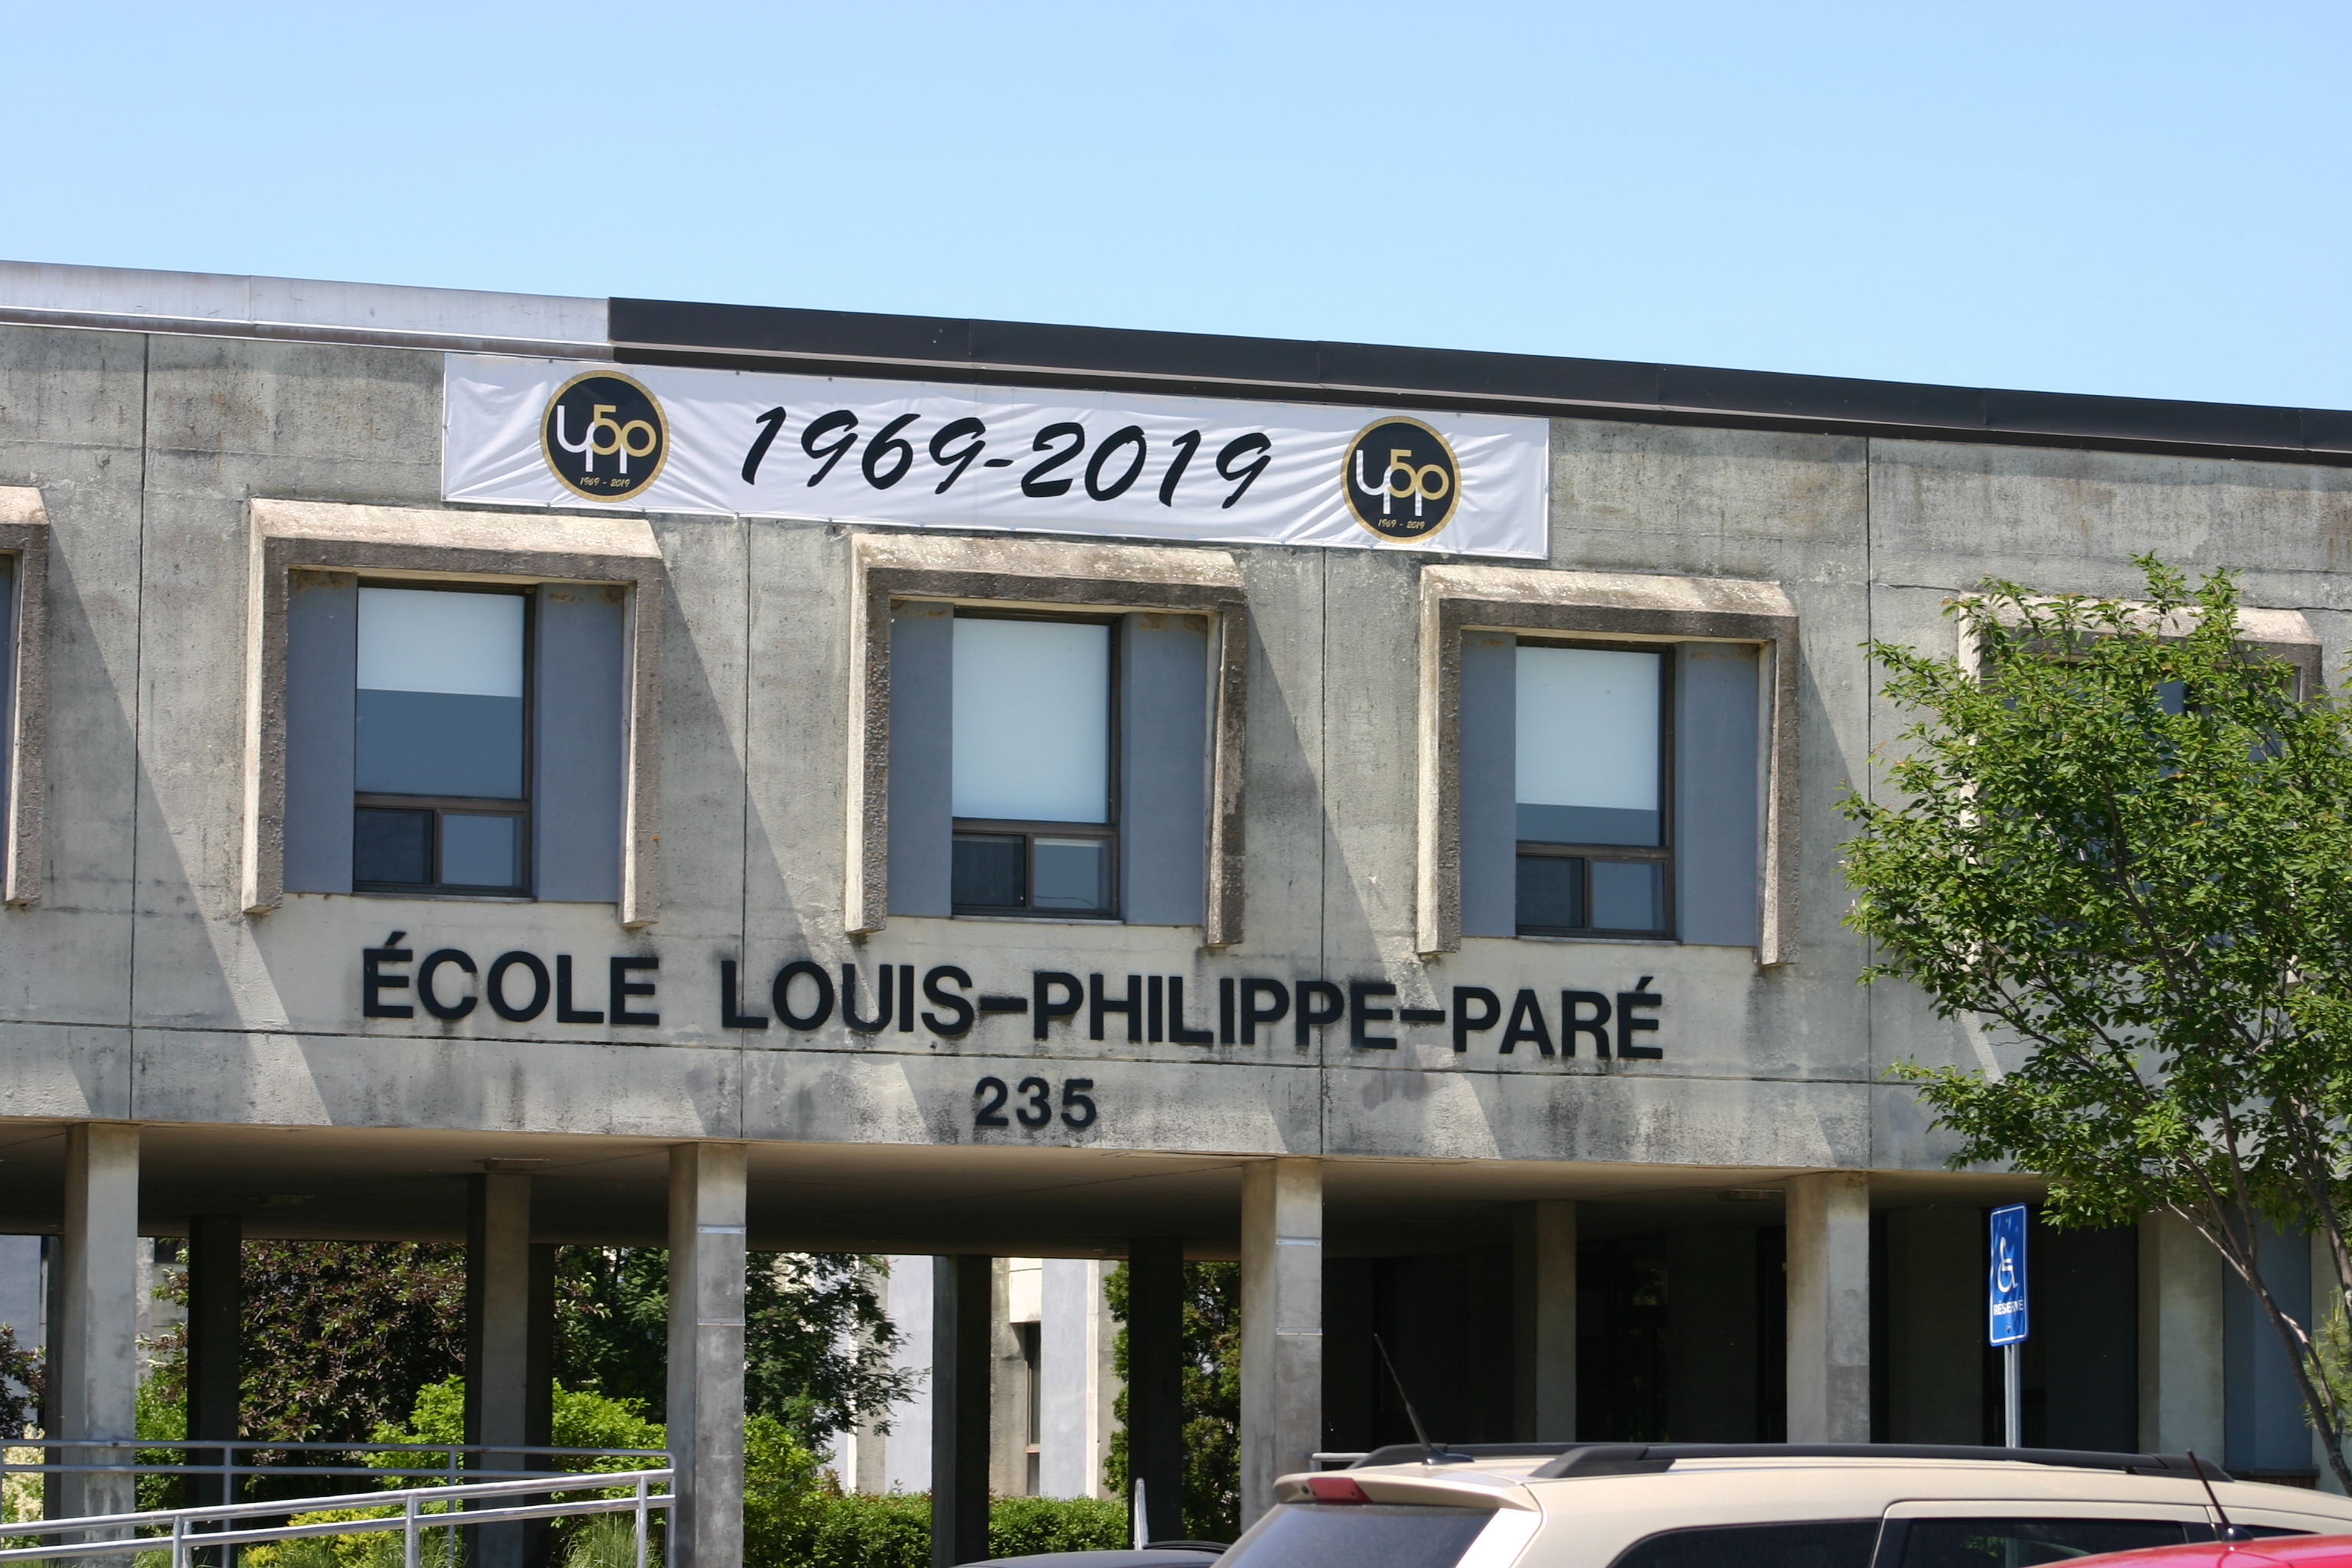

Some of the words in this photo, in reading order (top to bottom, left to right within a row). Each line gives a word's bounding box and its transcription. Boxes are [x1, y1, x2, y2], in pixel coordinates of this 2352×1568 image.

[741, 406, 1272, 509] 1969-2019
[363, 931, 660, 1024] ÉCOLE
[974, 1076, 1098, 1129] 235
